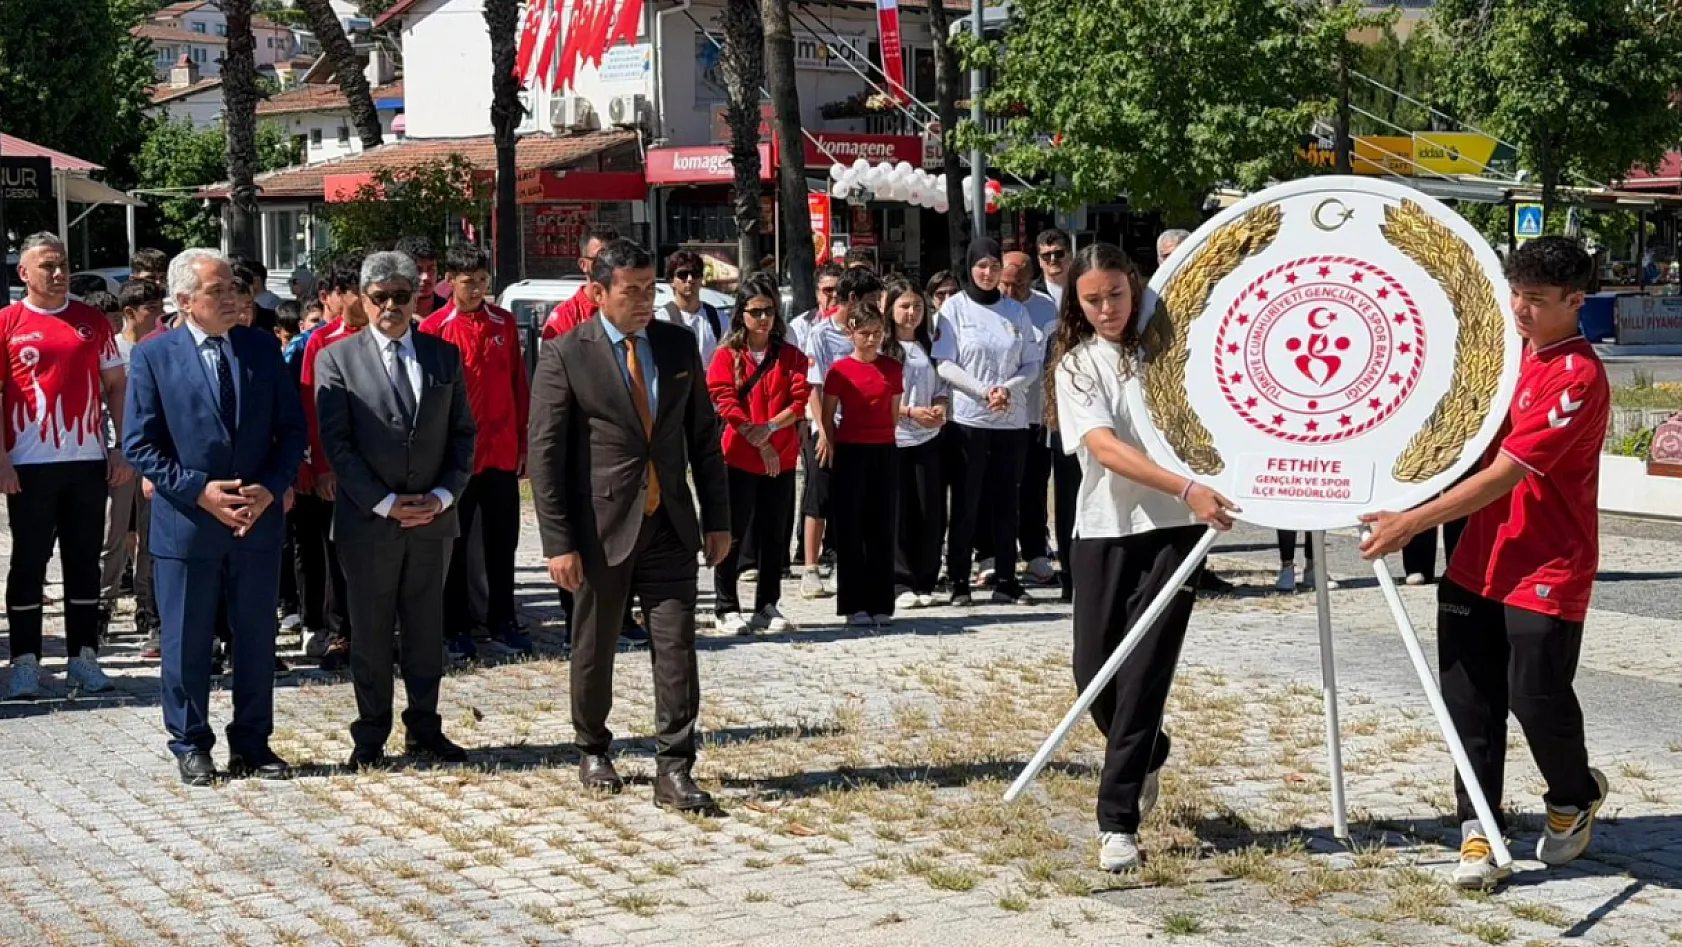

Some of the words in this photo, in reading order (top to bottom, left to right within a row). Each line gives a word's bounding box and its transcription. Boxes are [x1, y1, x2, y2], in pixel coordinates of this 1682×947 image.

[816, 134, 896, 161] komagene
[673, 151, 734, 175] komage
[1358, 298, 1372, 314] VE
[1368, 311, 1386, 342] SPOR
[1267, 457, 1342, 473] FETHİYE
[1255, 475, 1302, 487] GENÇLİK
[1304, 477, 1319, 486] VE
[1321, 478, 1350, 487] SPOR
[1252, 485, 1275, 497] İLÇE
[1278, 486, 1352, 499] MÜDÜRLÜĞÜ
